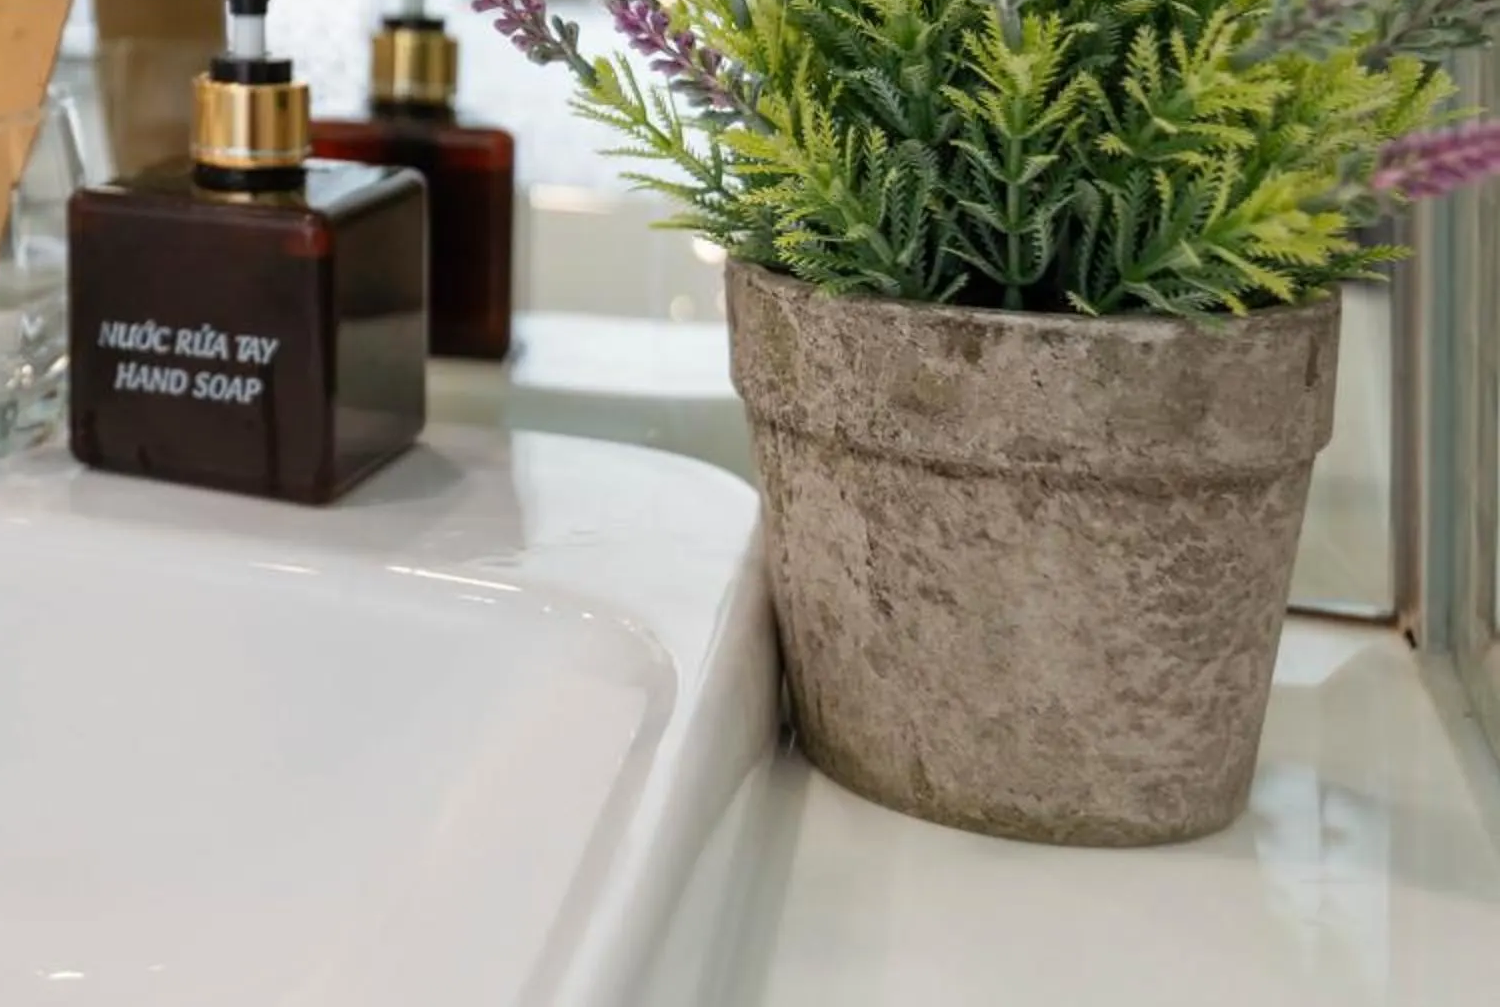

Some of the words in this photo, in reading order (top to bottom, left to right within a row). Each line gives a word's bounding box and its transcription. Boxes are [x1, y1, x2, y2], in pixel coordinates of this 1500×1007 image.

[236, 336, 277, 363] TAY
[115, 364, 187, 393] HAND
[193, 373, 262, 402] SOAP
